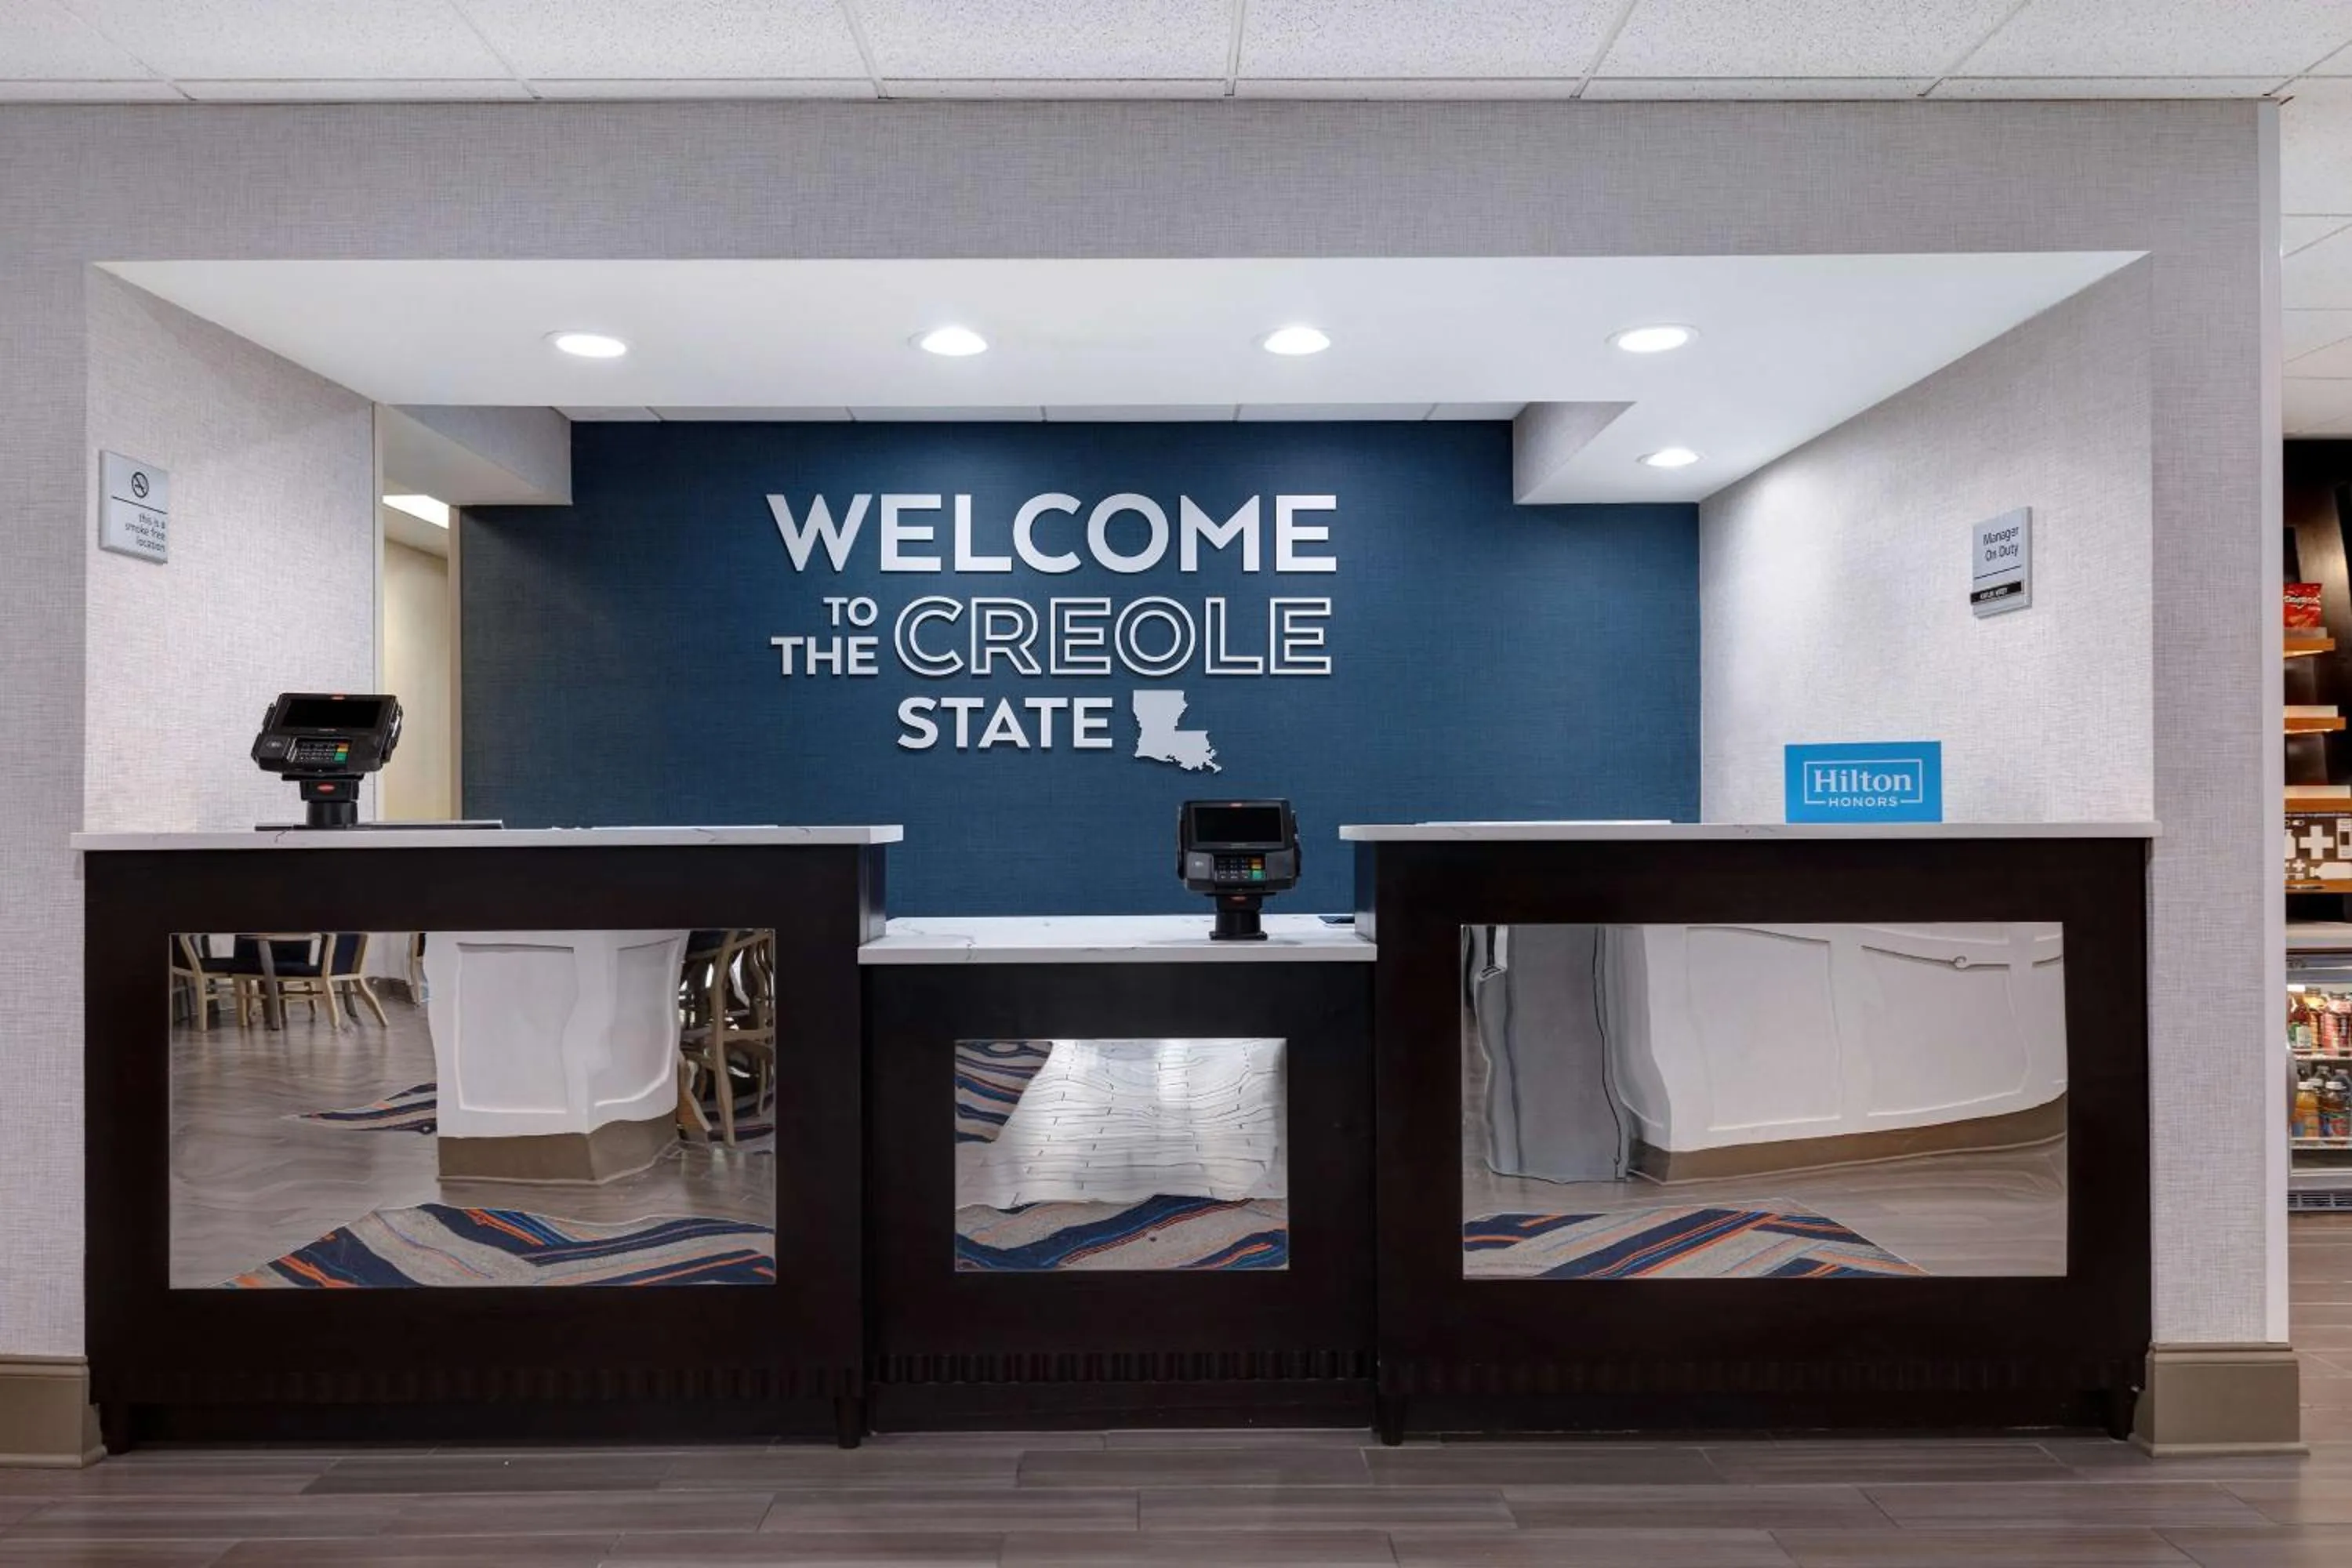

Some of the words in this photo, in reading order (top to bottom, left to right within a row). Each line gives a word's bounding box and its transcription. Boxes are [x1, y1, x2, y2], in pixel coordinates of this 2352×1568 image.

[125, 522, 149, 537] smoke
[151, 527, 165, 541] free
[765, 492, 1338, 574] WELCOME
[1983, 526, 2019, 546] Manager
[136, 536, 165, 553] location
[1984, 549, 1997, 562] On
[1998, 543, 2019, 557] Duty
[822, 596, 879, 627] TO
[770, 635, 880, 676] THE
[894, 595, 1333, 677] CREOLE
[896, 696, 1114, 750] STATE
[1813, 768, 1913, 793] Hilton
[1828, 795, 1899, 808] HONORS
